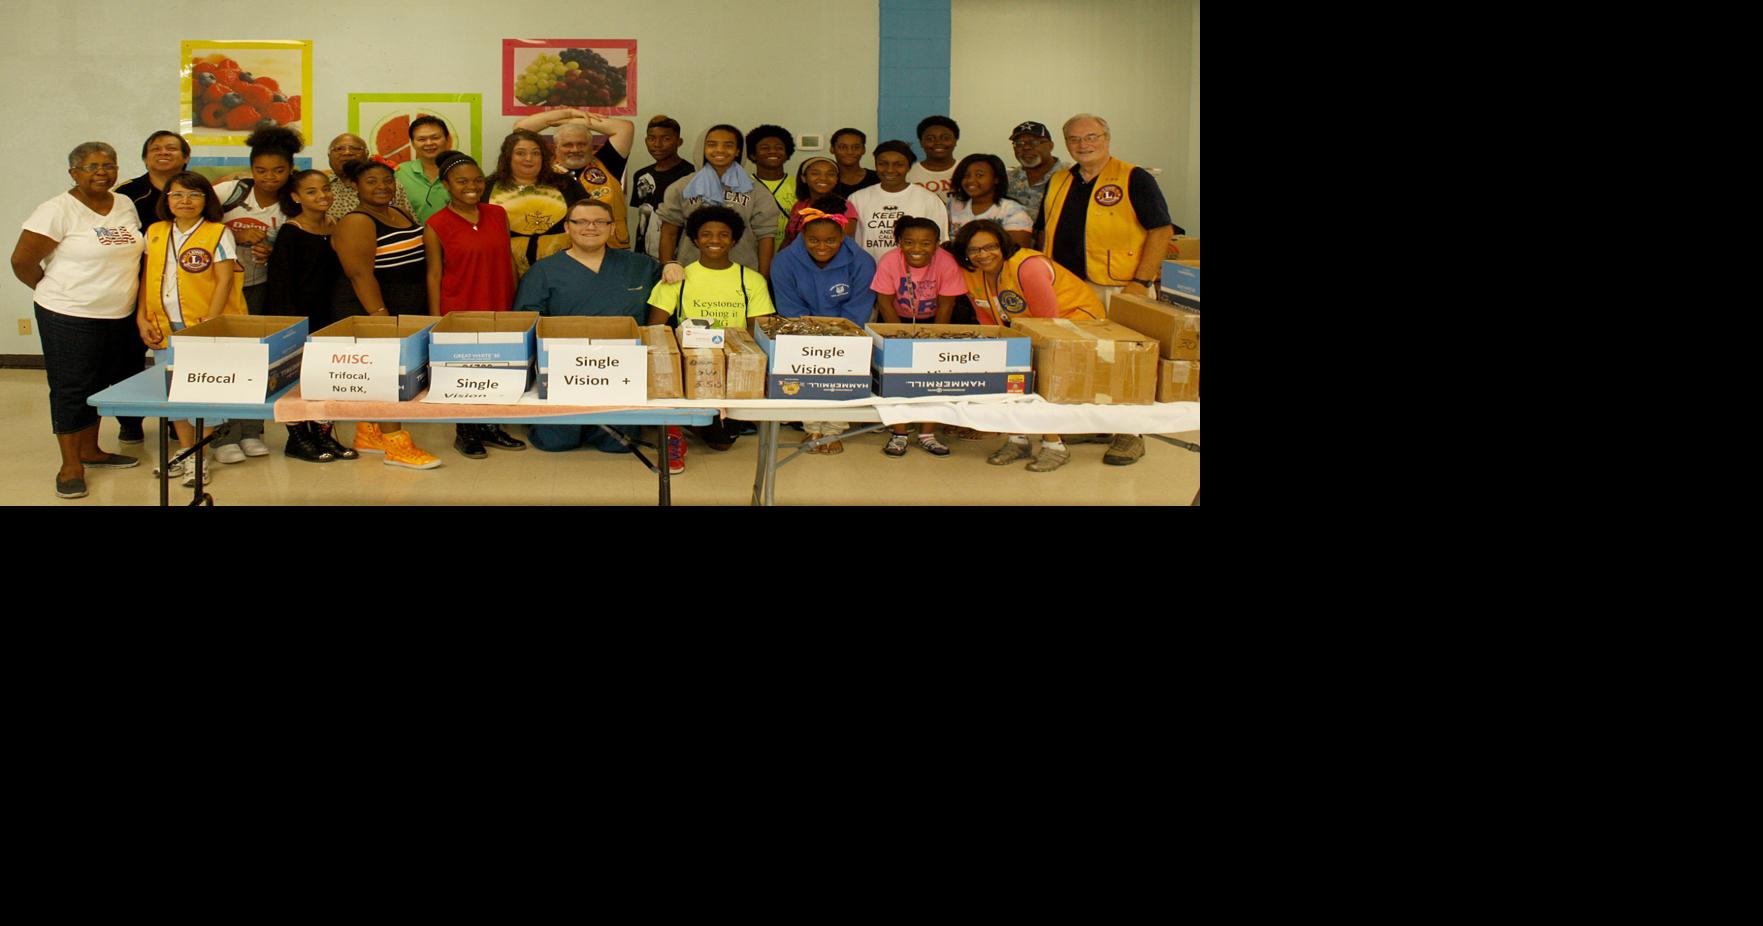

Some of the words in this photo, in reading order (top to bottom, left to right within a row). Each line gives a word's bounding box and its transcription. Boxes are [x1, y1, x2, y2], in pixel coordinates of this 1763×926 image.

[872, 211, 904, 219] KEEP
[867, 220, 895, 228] CAL
[866, 239, 899, 248] BATMA
[693, 300, 745, 309] Keystoners
[700, 310, 729, 318] Doing
[801, 346, 845, 359] Single
[938, 351, 981, 364] Single
[331, 354, 373, 365] MISC.
[575, 356, 620, 369] Single
[791, 364, 835, 375] Vision
[187, 372, 236, 384] Bifocal
[328, 371, 370, 381] Trifocal,
[563, 375, 609, 386] Vision
[622, 377, 631, 385] +
[456, 378, 499, 391] Single
[910, 380, 986, 388] HAMMERMILL
[332, 385, 347, 393] No
[350, 385, 367, 394] RX,
